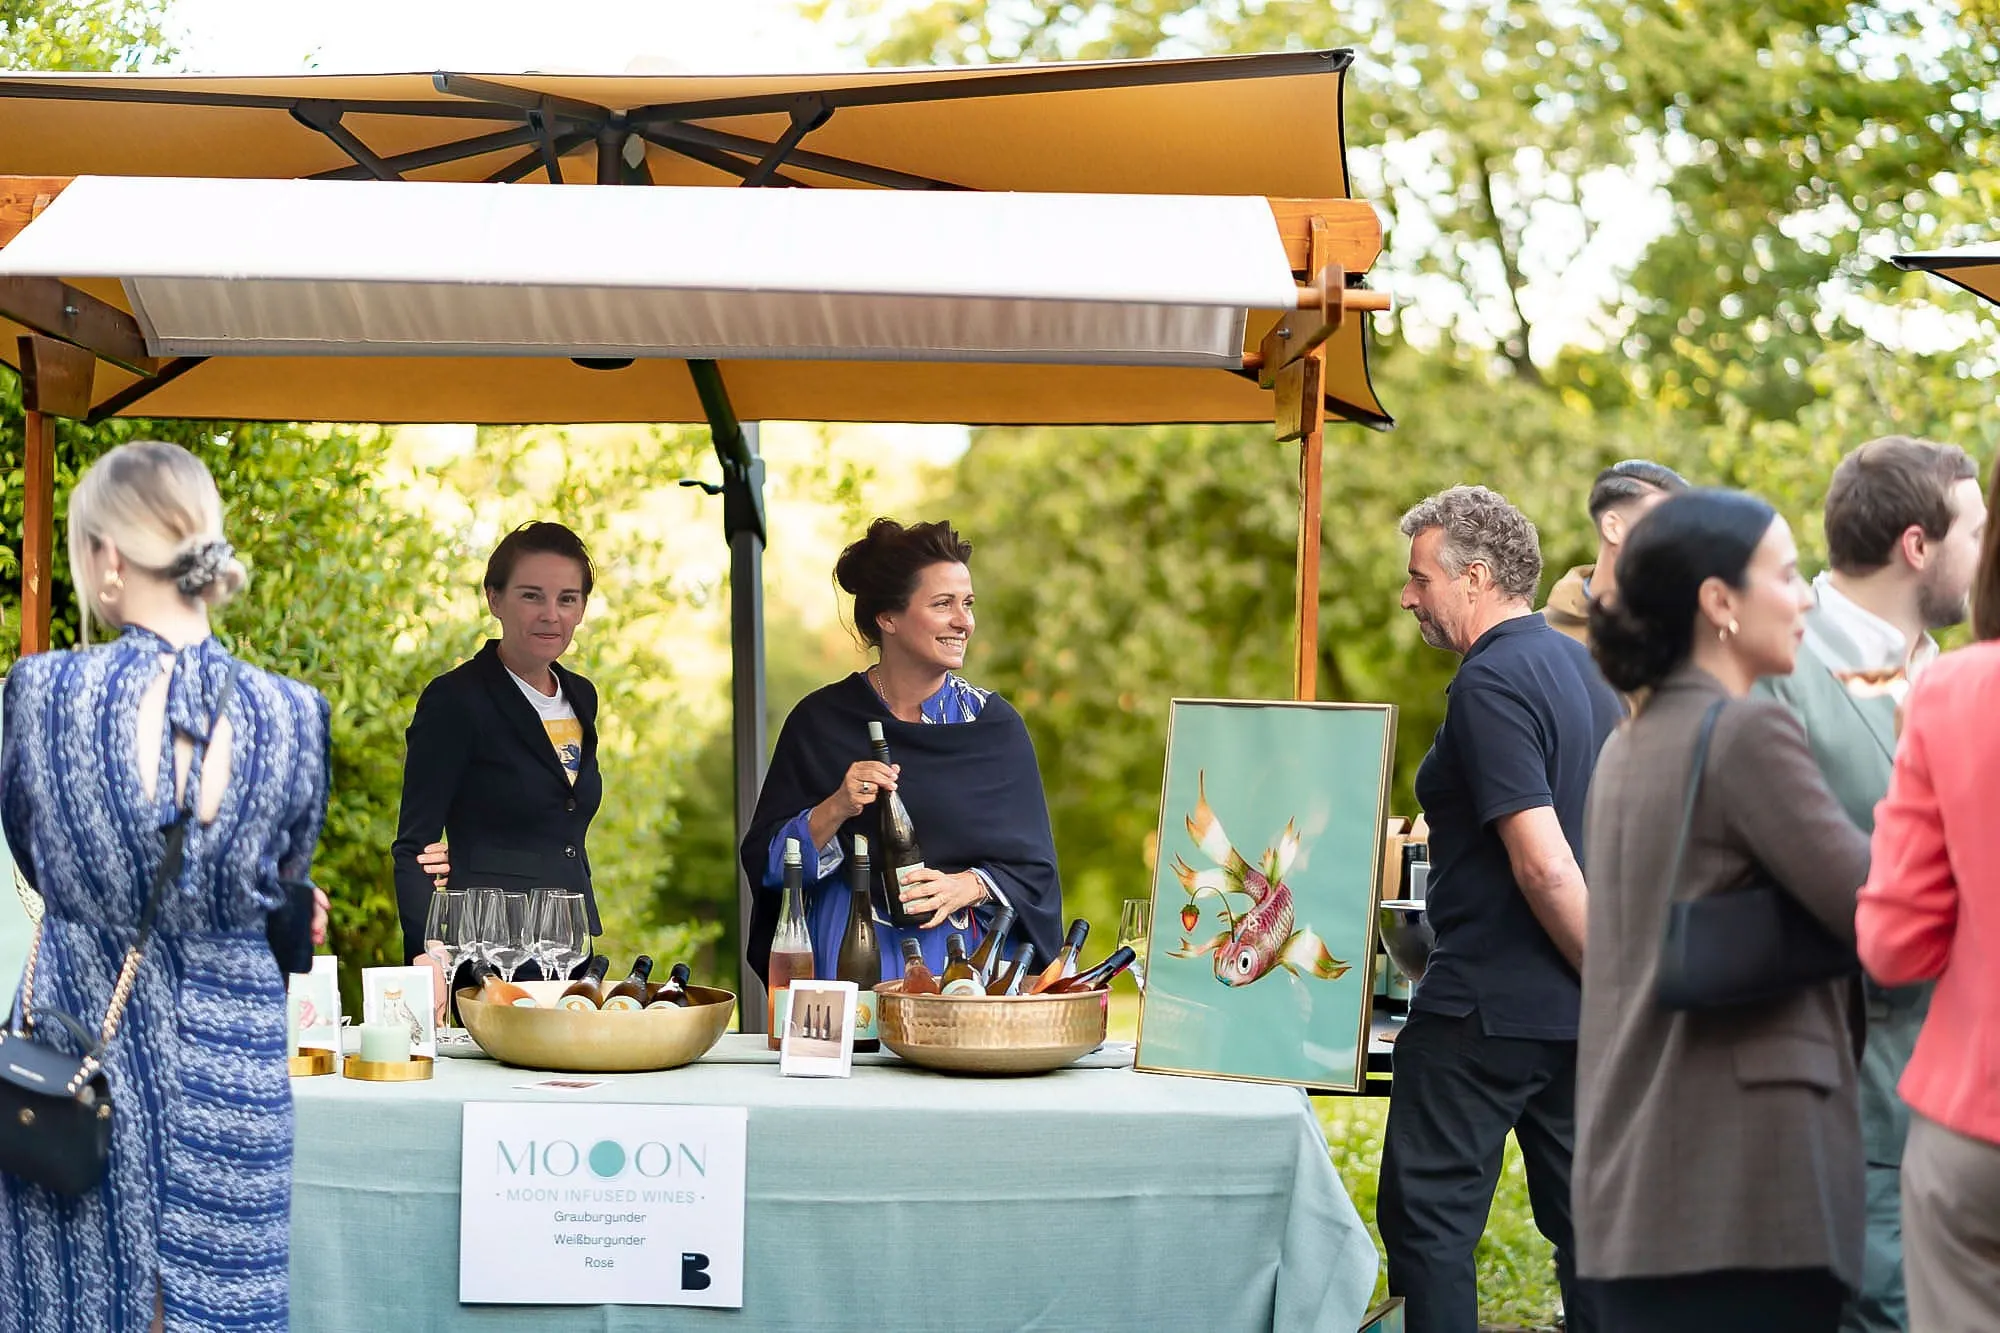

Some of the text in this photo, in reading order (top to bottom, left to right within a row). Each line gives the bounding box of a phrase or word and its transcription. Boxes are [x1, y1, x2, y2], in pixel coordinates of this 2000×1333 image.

[506, 1188, 696, 1204] MOON INFUSED WINES
[554, 1211, 647, 1225] Grauburgunder
[554, 1233, 647, 1248] Weißburgunder
[681, 1252, 712, 1291] B
